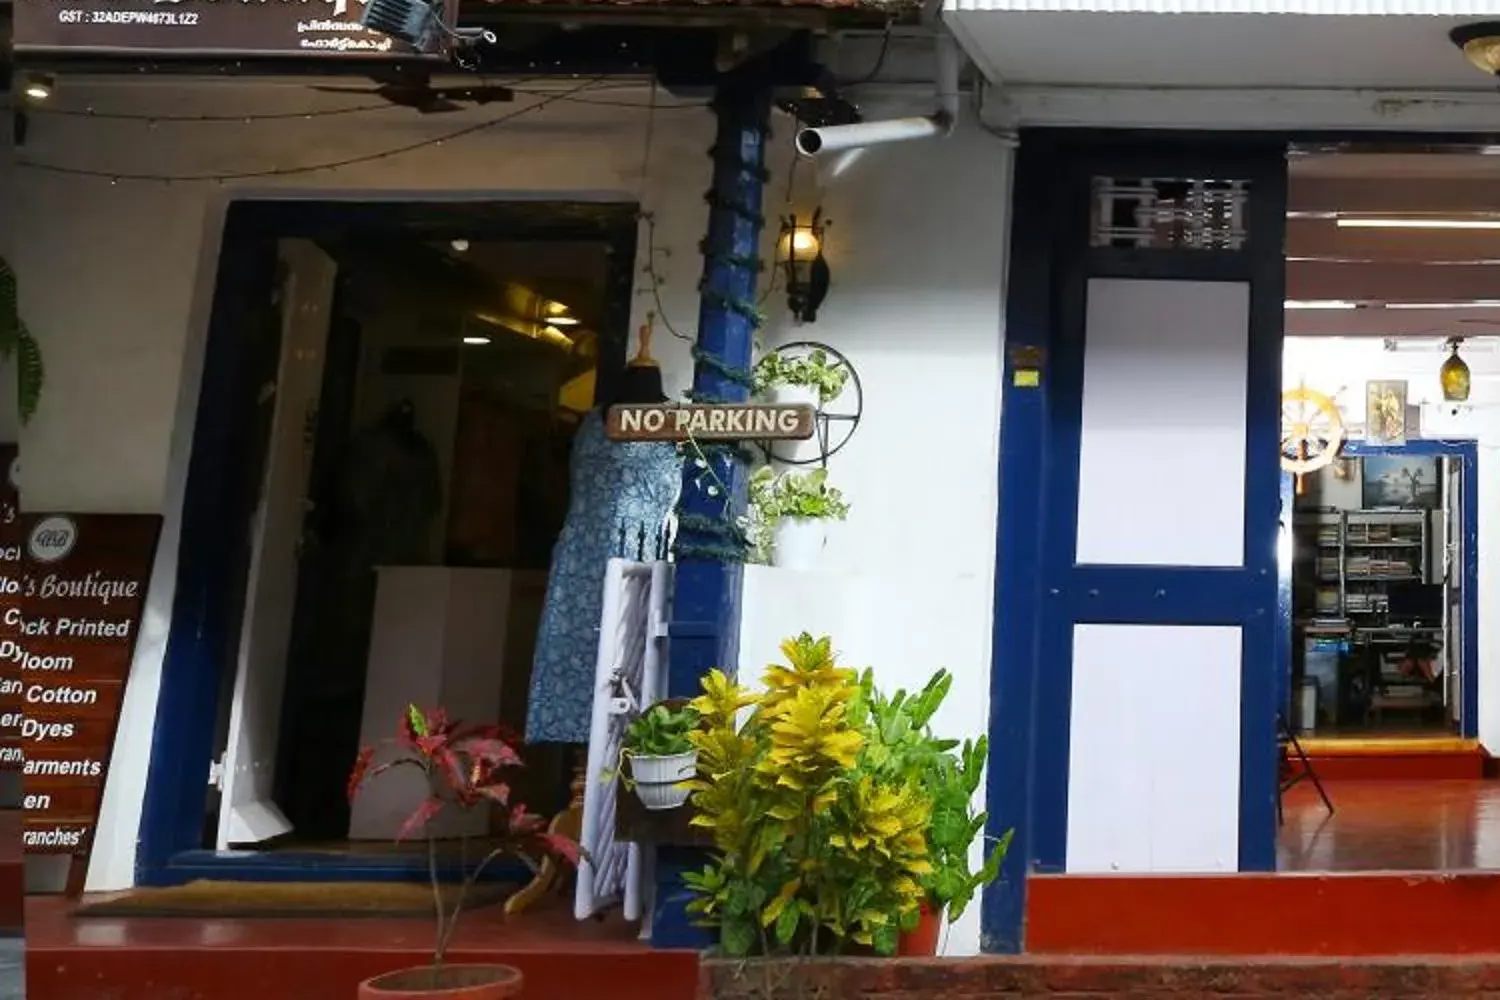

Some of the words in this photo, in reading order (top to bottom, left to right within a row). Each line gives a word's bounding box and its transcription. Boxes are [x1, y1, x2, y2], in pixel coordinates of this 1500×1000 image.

[59, 9, 83, 23] GST
[620, 409, 664, 432] NO
[675, 409, 799, 432] PARKING
[40, 570, 139, 605] Boutique
[55, 617, 131, 638] Printed
[26, 685, 97, 703] Cotton
[22, 719, 75, 741] Dyes
